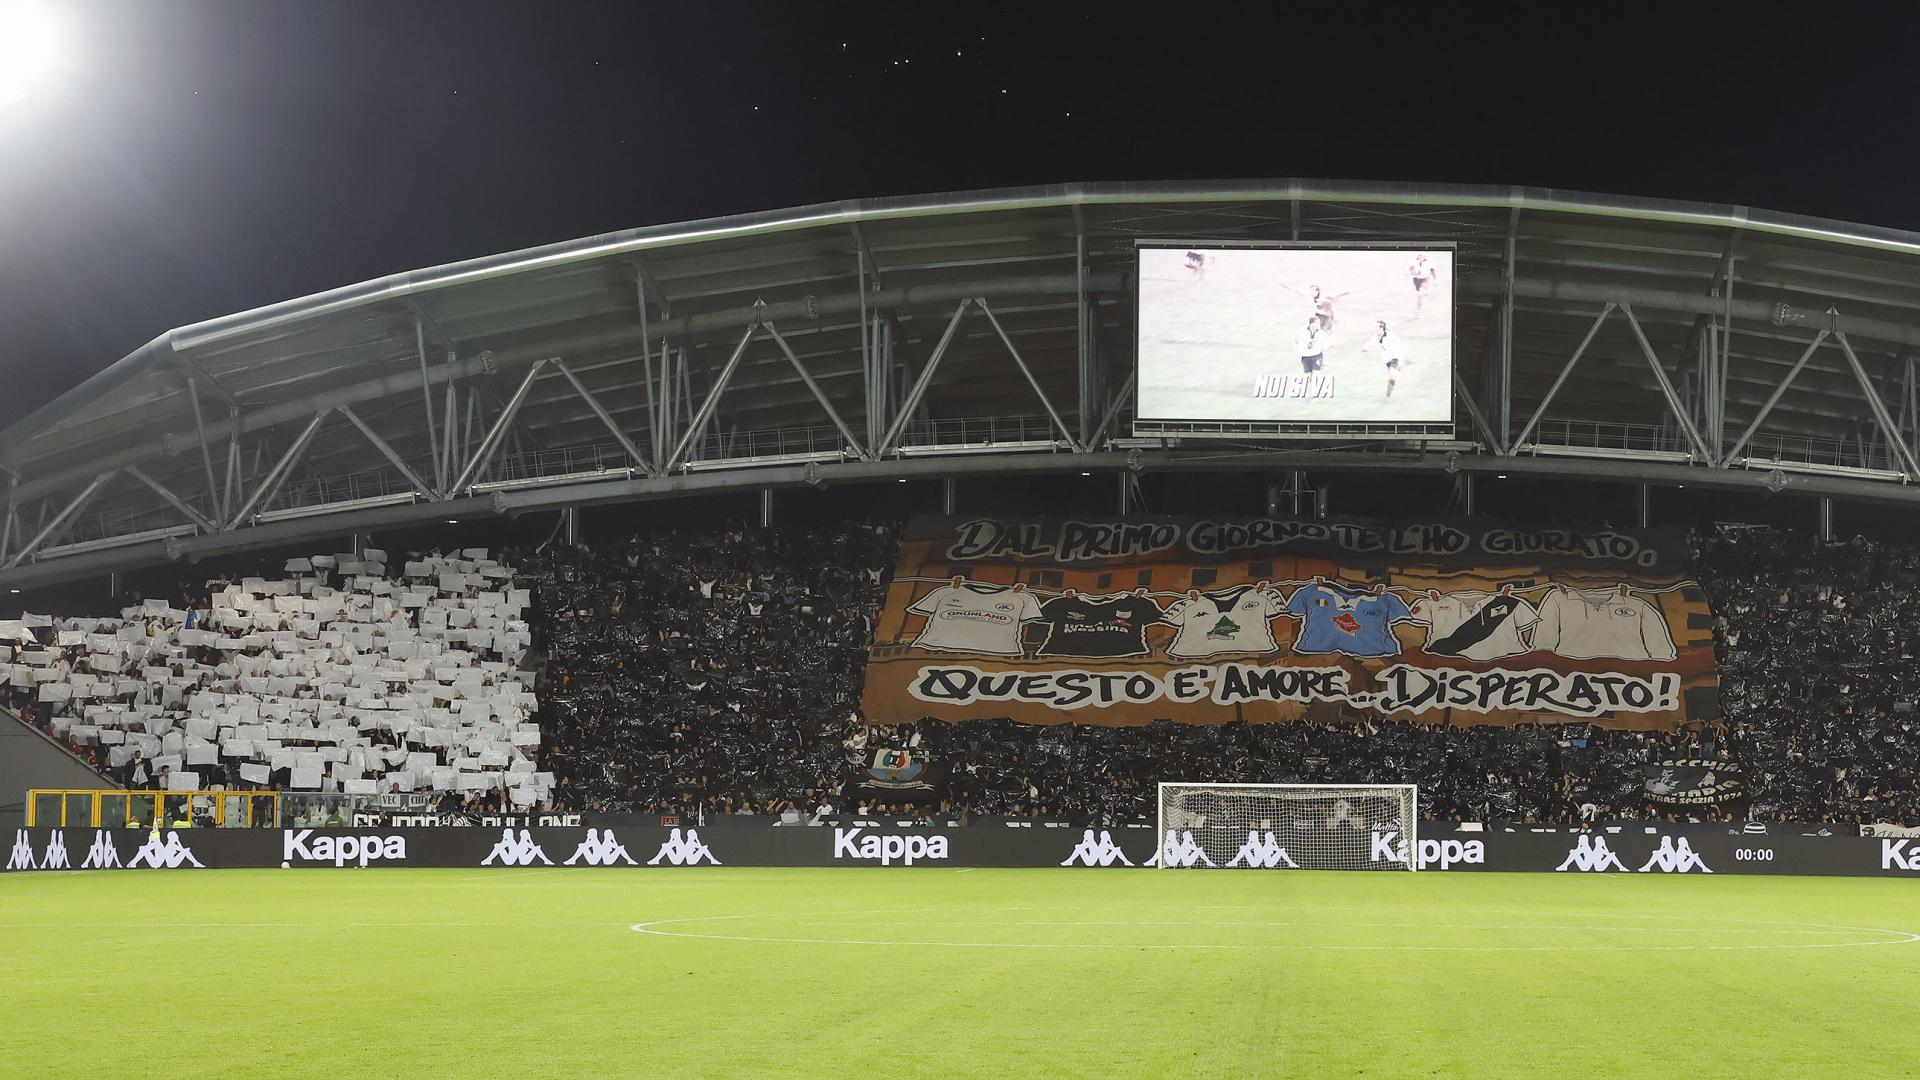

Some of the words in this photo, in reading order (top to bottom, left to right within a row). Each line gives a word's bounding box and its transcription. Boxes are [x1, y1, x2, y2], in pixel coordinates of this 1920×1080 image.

[1253, 375, 1288, 398] NOI
[1289, 375, 1310, 398] SI
[1311, 375, 1335, 398] VA
[949, 520, 1052, 558] DAL
[1188, 521, 1328, 552] GIORNO
[1334, 524, 1382, 551] TE
[918, 668, 1157, 706] QUESTO
[284, 829, 407, 867] Kappa
[834, 828, 949, 866] Kappa
[1735, 848, 1774, 861] 00:00
